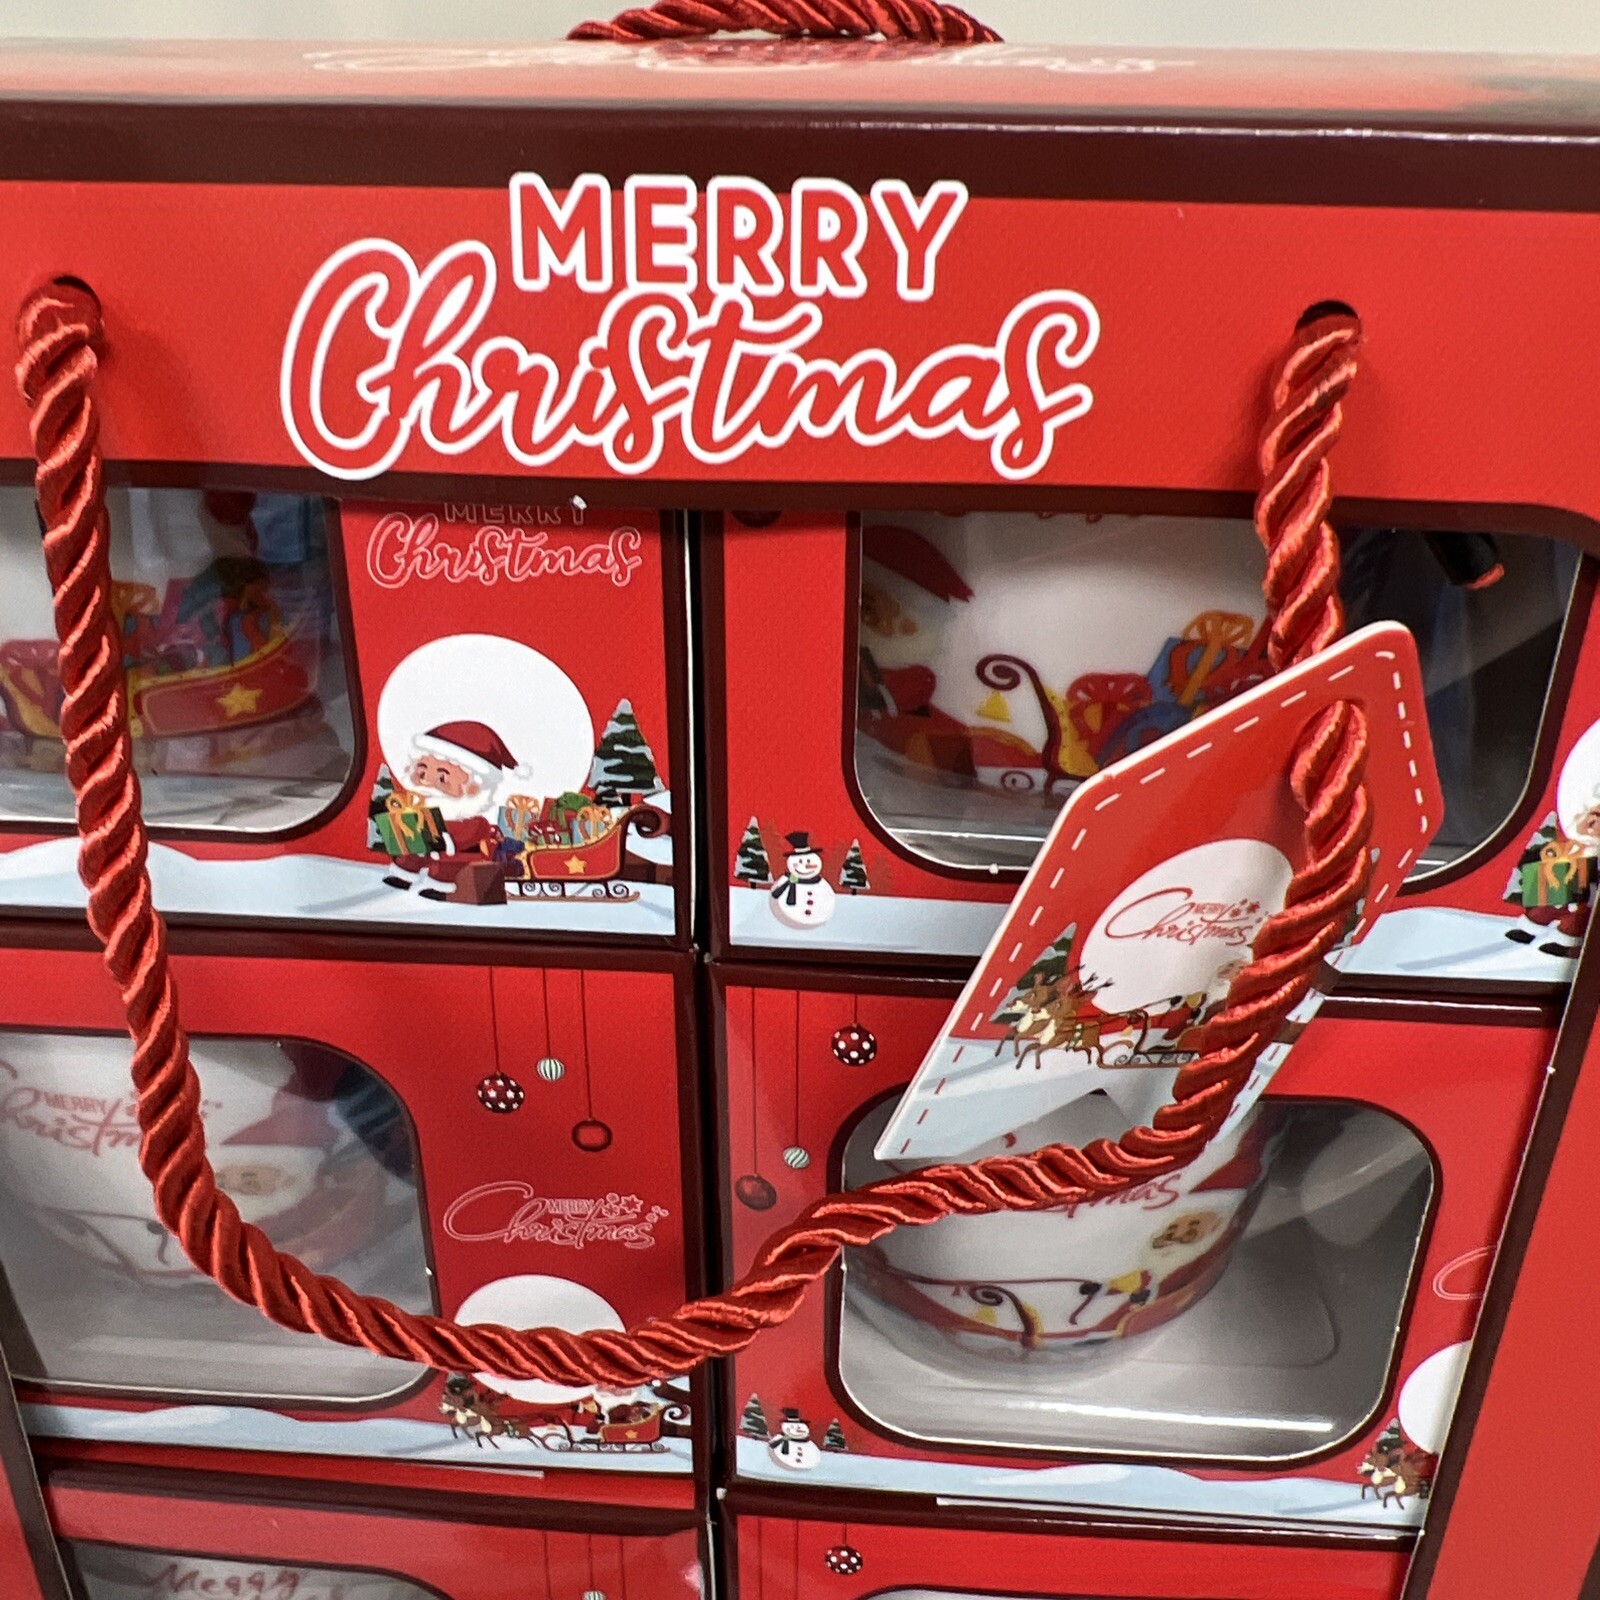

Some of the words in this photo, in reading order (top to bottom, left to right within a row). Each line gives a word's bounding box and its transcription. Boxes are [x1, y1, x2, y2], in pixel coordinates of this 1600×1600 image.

[508, 172, 968, 302] MERRY
[280, 238, 1101, 480] Christmas
[366, 511, 642, 588] Christmas
[1105, 887, 1253, 946] Christmas
[443, 1180, 655, 1249] Christmas
